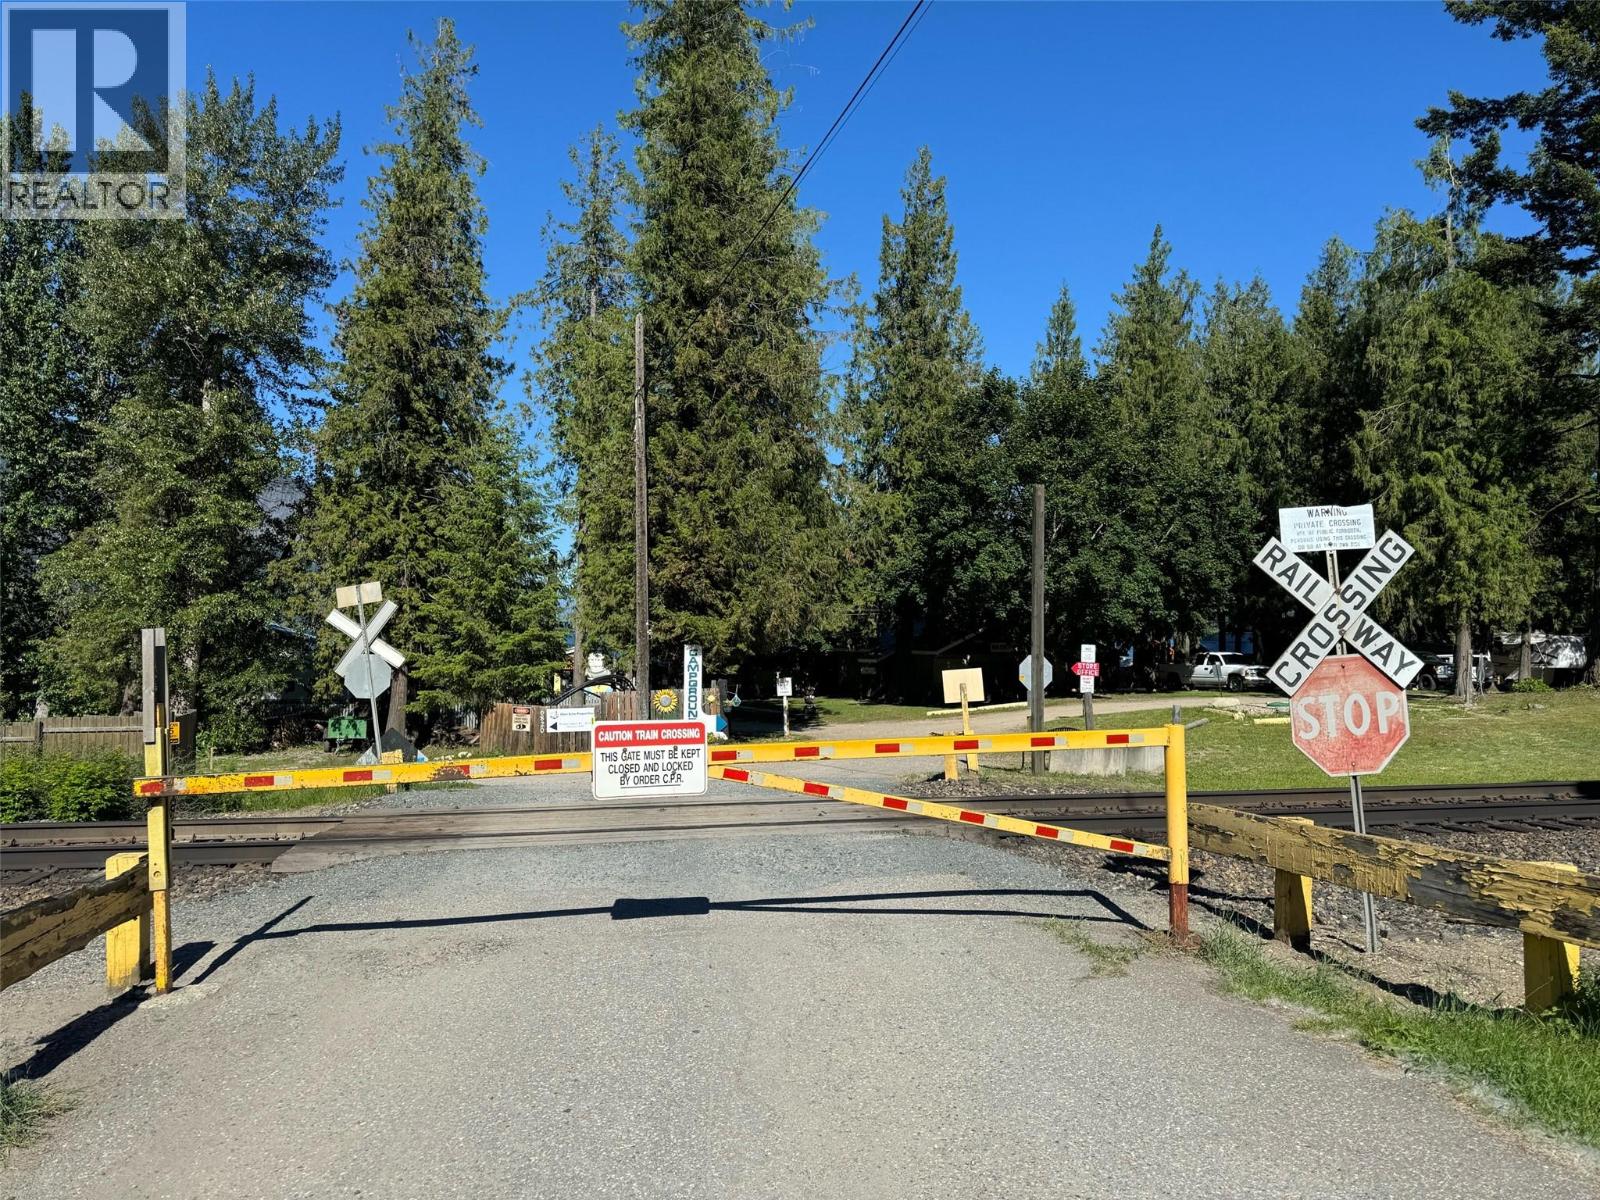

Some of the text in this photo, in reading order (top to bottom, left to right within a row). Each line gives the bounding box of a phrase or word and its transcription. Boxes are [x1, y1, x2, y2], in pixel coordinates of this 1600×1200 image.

[1306, 508, 1348, 519] WARNING
[1293, 518, 1362, 529] PRIVATE CROSSING
[1261, 544, 1416, 677] RAIL WAY
[1274, 537, 1407, 688] CROSSING
[1076, 669, 1100, 677] OFFICE
[688, 649, 699, 720] CAMPGROUN
[1297, 690, 1400, 741] STOP
[598, 728, 701, 742] CAUTION TRAIN CROSSING
[600, 748, 701, 762] THIS GATE MUST BE KEPT
[608, 760, 694, 775] CLOSED AND LOCKED
[620, 773, 685, 786] BY ORDER C.P.R.
